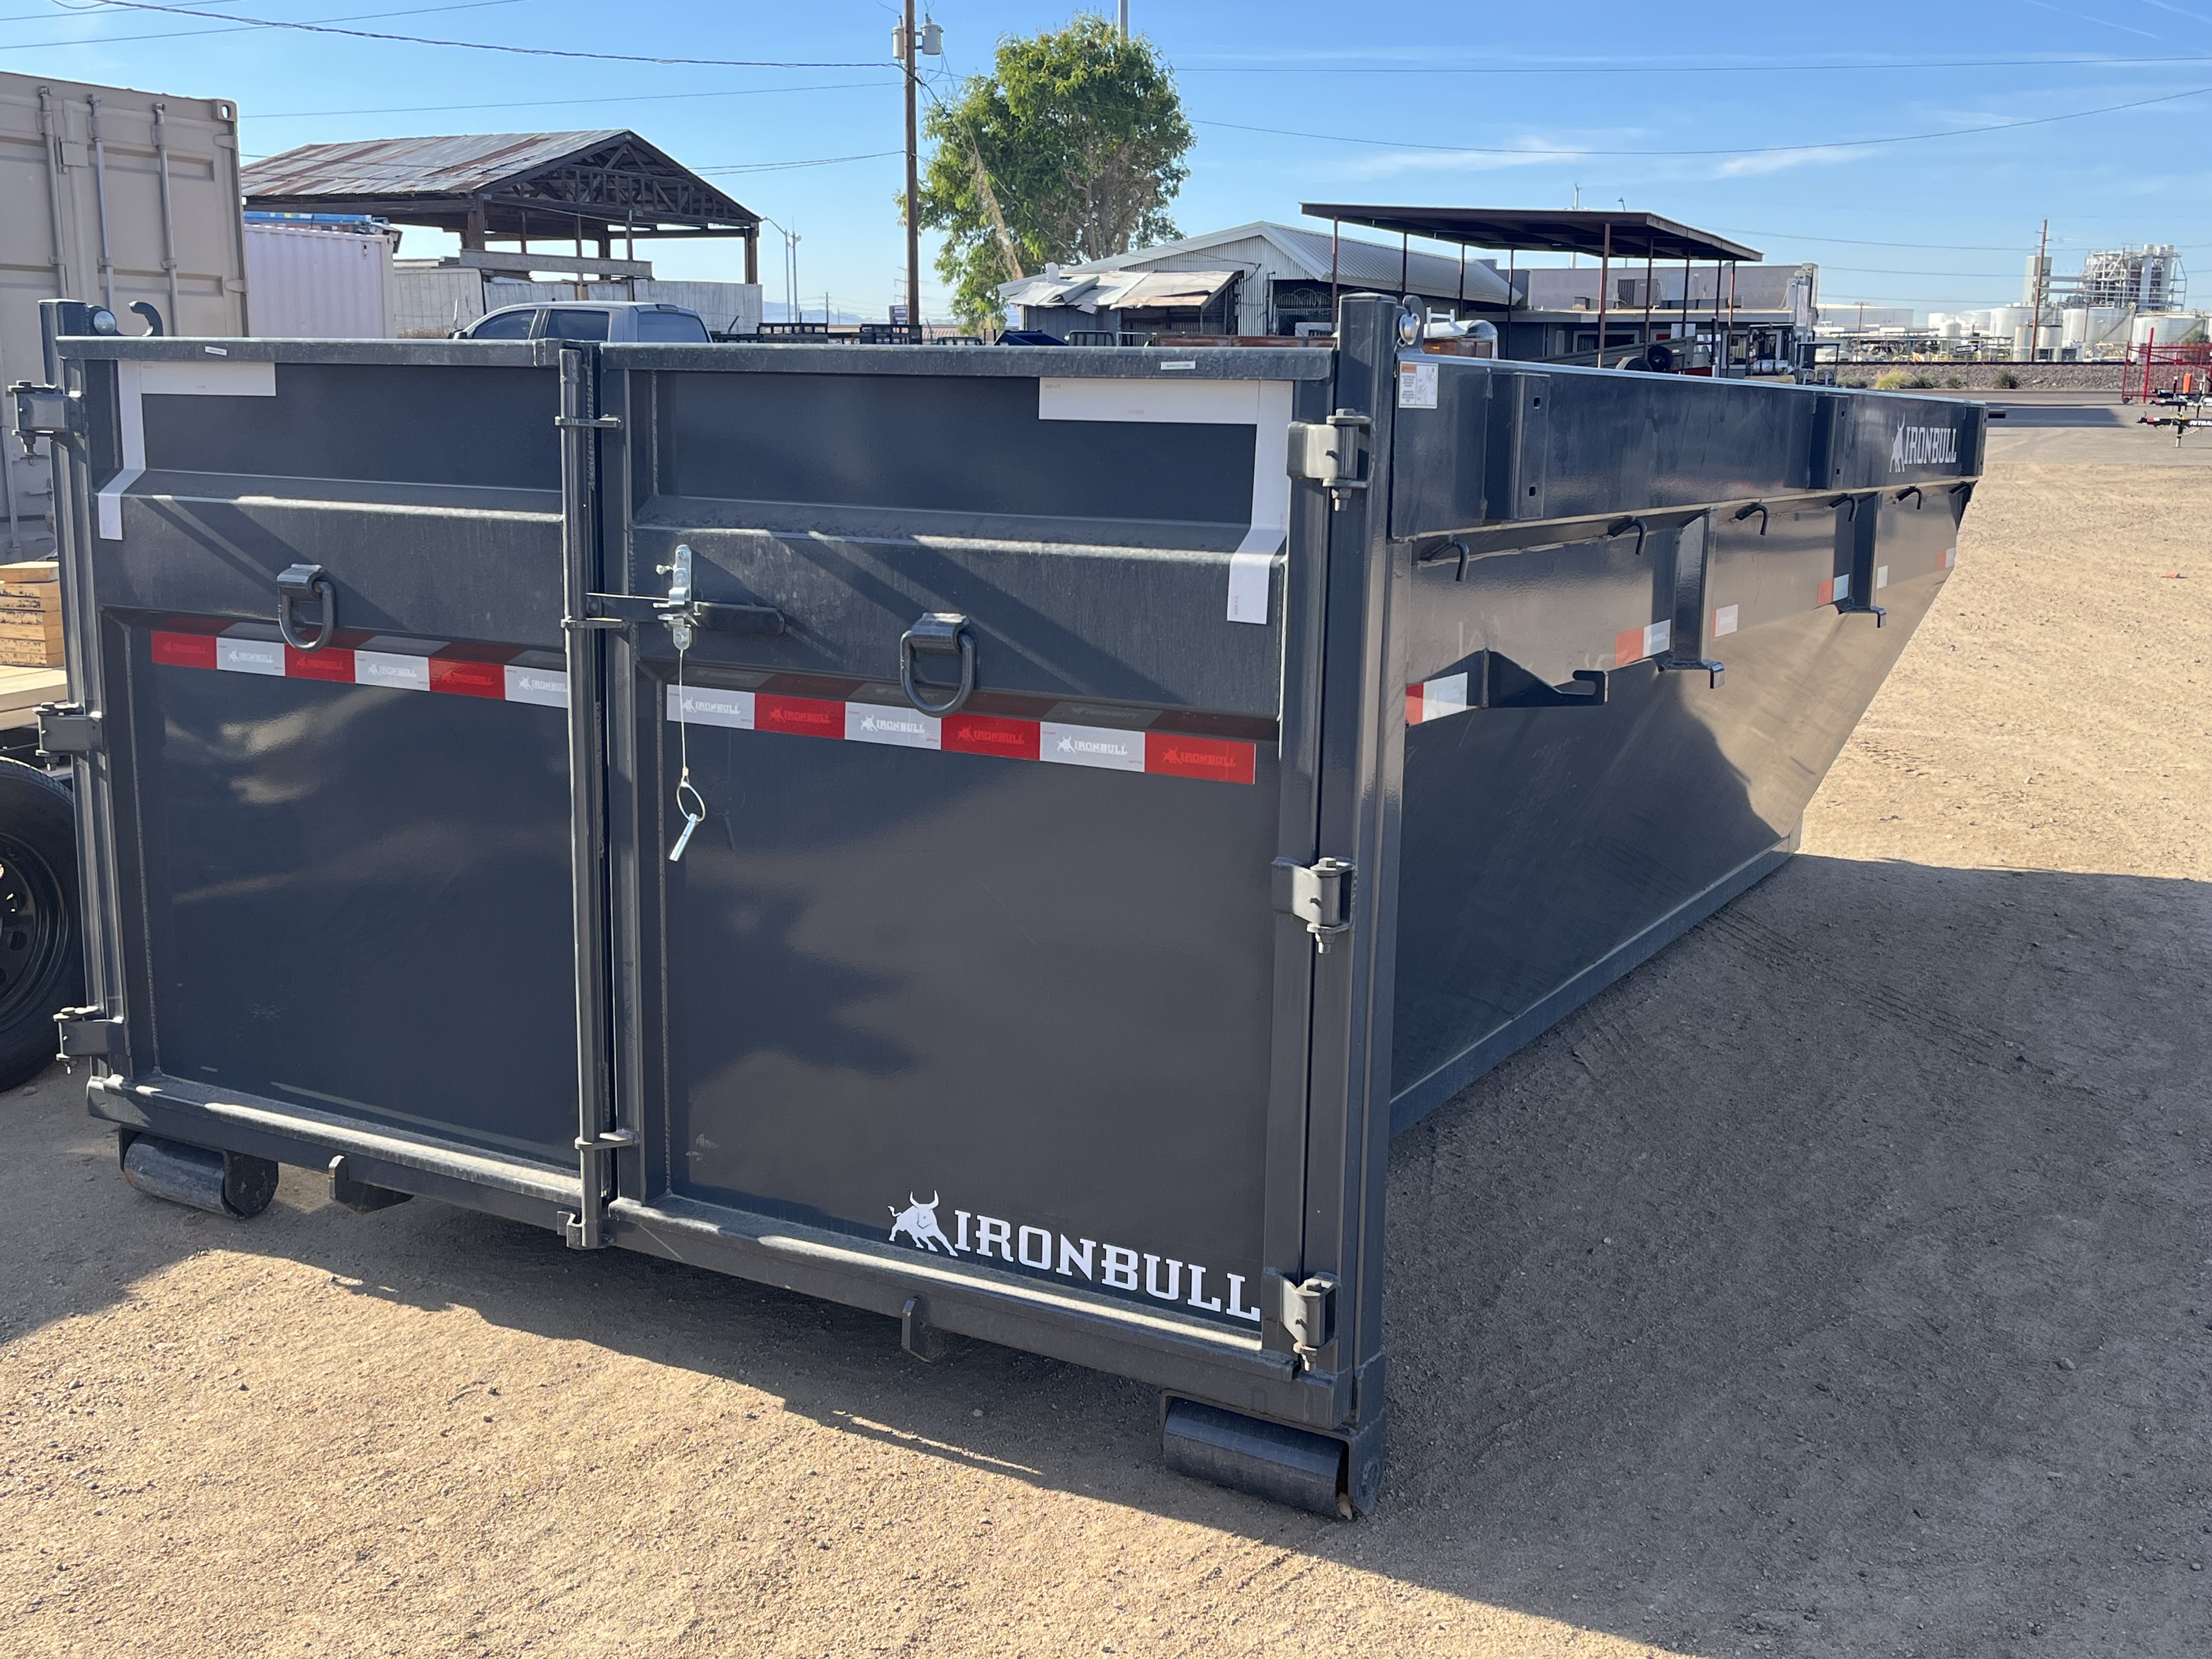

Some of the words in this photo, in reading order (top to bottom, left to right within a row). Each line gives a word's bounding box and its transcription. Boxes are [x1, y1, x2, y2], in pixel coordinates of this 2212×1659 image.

[1904, 426, 1957, 465] IRONBULL
[379, 665, 417, 678] IRONBULL
[695, 701, 740, 715] IRONBULL
[783, 710, 831, 724] IRONBULL
[876, 719, 926, 733] IRONBULL
[974, 730, 1025, 744] IRONBULL
[1074, 741, 1128, 755] IRONBULL
[1181, 752, 1237, 768] IRONBULL
[955, 1210, 1260, 1322] IRONBULL
